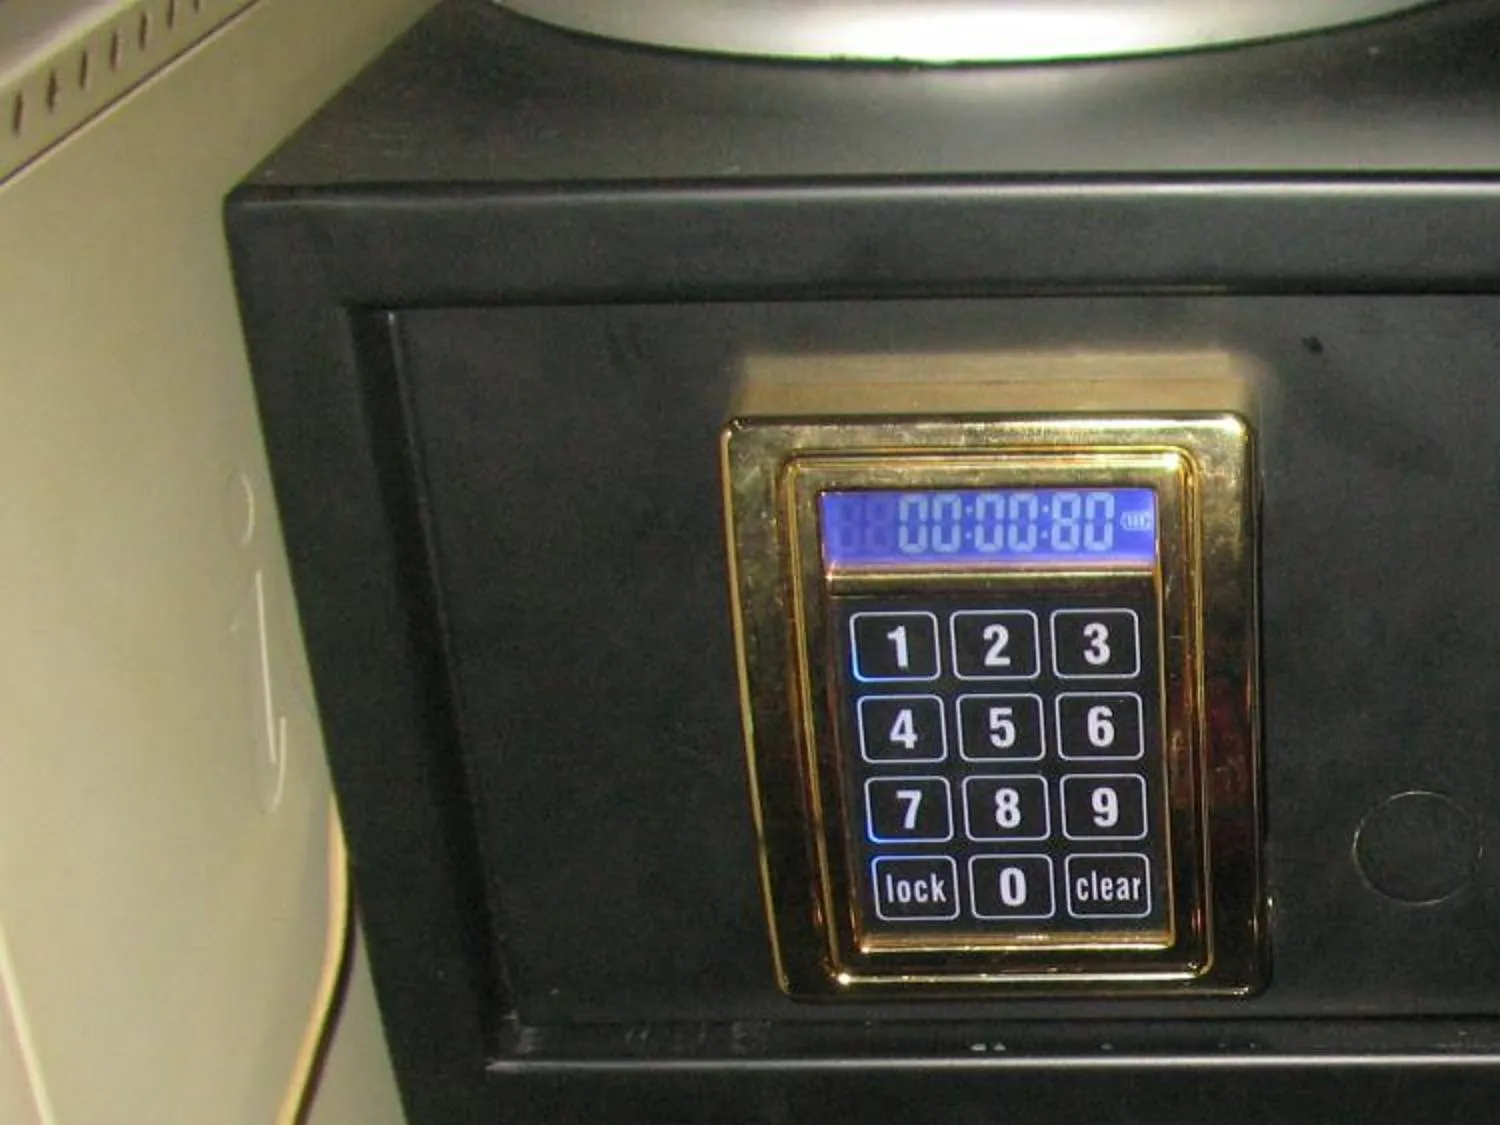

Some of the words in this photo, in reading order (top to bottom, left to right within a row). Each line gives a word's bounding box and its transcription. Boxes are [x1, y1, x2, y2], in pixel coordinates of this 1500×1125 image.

[887, 625, 908, 668] 1
[982, 624, 1011, 666] 2
[1083, 623, 1111, 665] 3
[890, 709, 918, 749] 4
[990, 707, 1016, 748] 5
[1087, 706, 1115, 746] 6
[897, 790, 923, 829] 7
[995, 788, 1021, 828] 8
[1092, 787, 1119, 827] 9
[886, 872, 947, 904] lock
[1000, 867, 1028, 906] 0
[1076, 869, 1142, 901] clear
